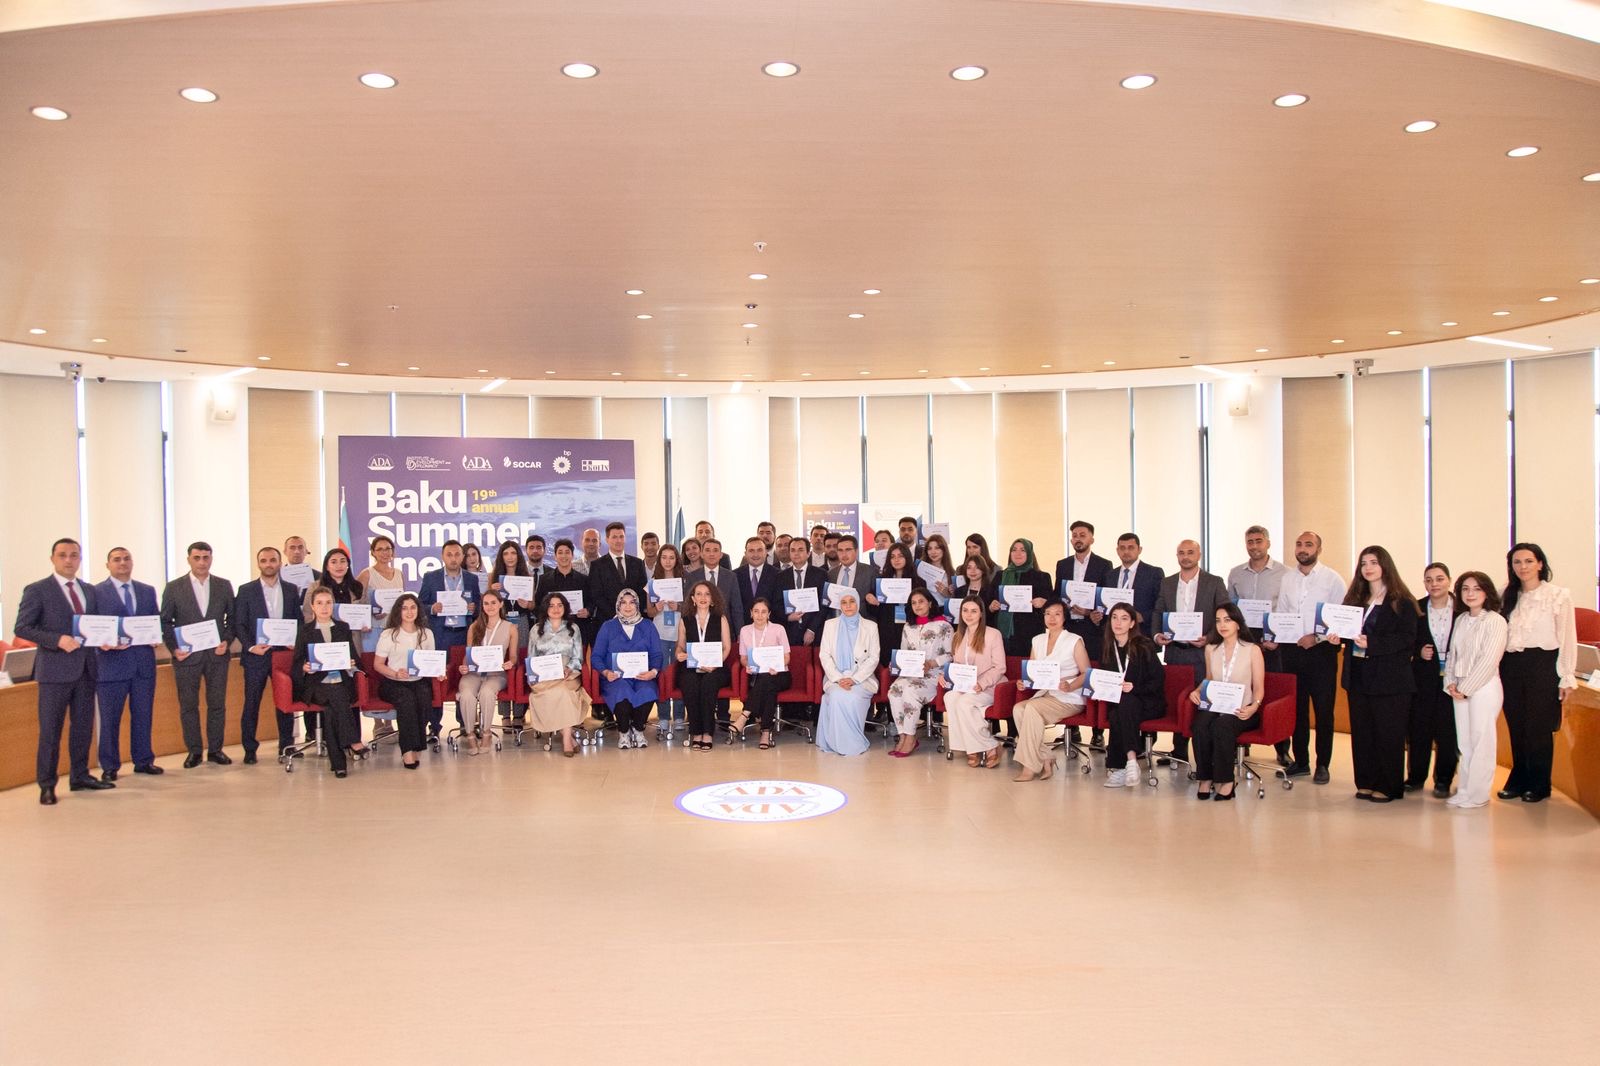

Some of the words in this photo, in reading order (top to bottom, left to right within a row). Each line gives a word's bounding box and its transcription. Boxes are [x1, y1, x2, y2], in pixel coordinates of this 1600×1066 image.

[370, 458, 391, 466] ADA
[467, 457, 492, 469] ADA
[367, 480, 467, 514] Baku
[472, 489, 497, 501] 19th
[471, 500, 518, 513] annual
[367, 515, 535, 548] Summer
